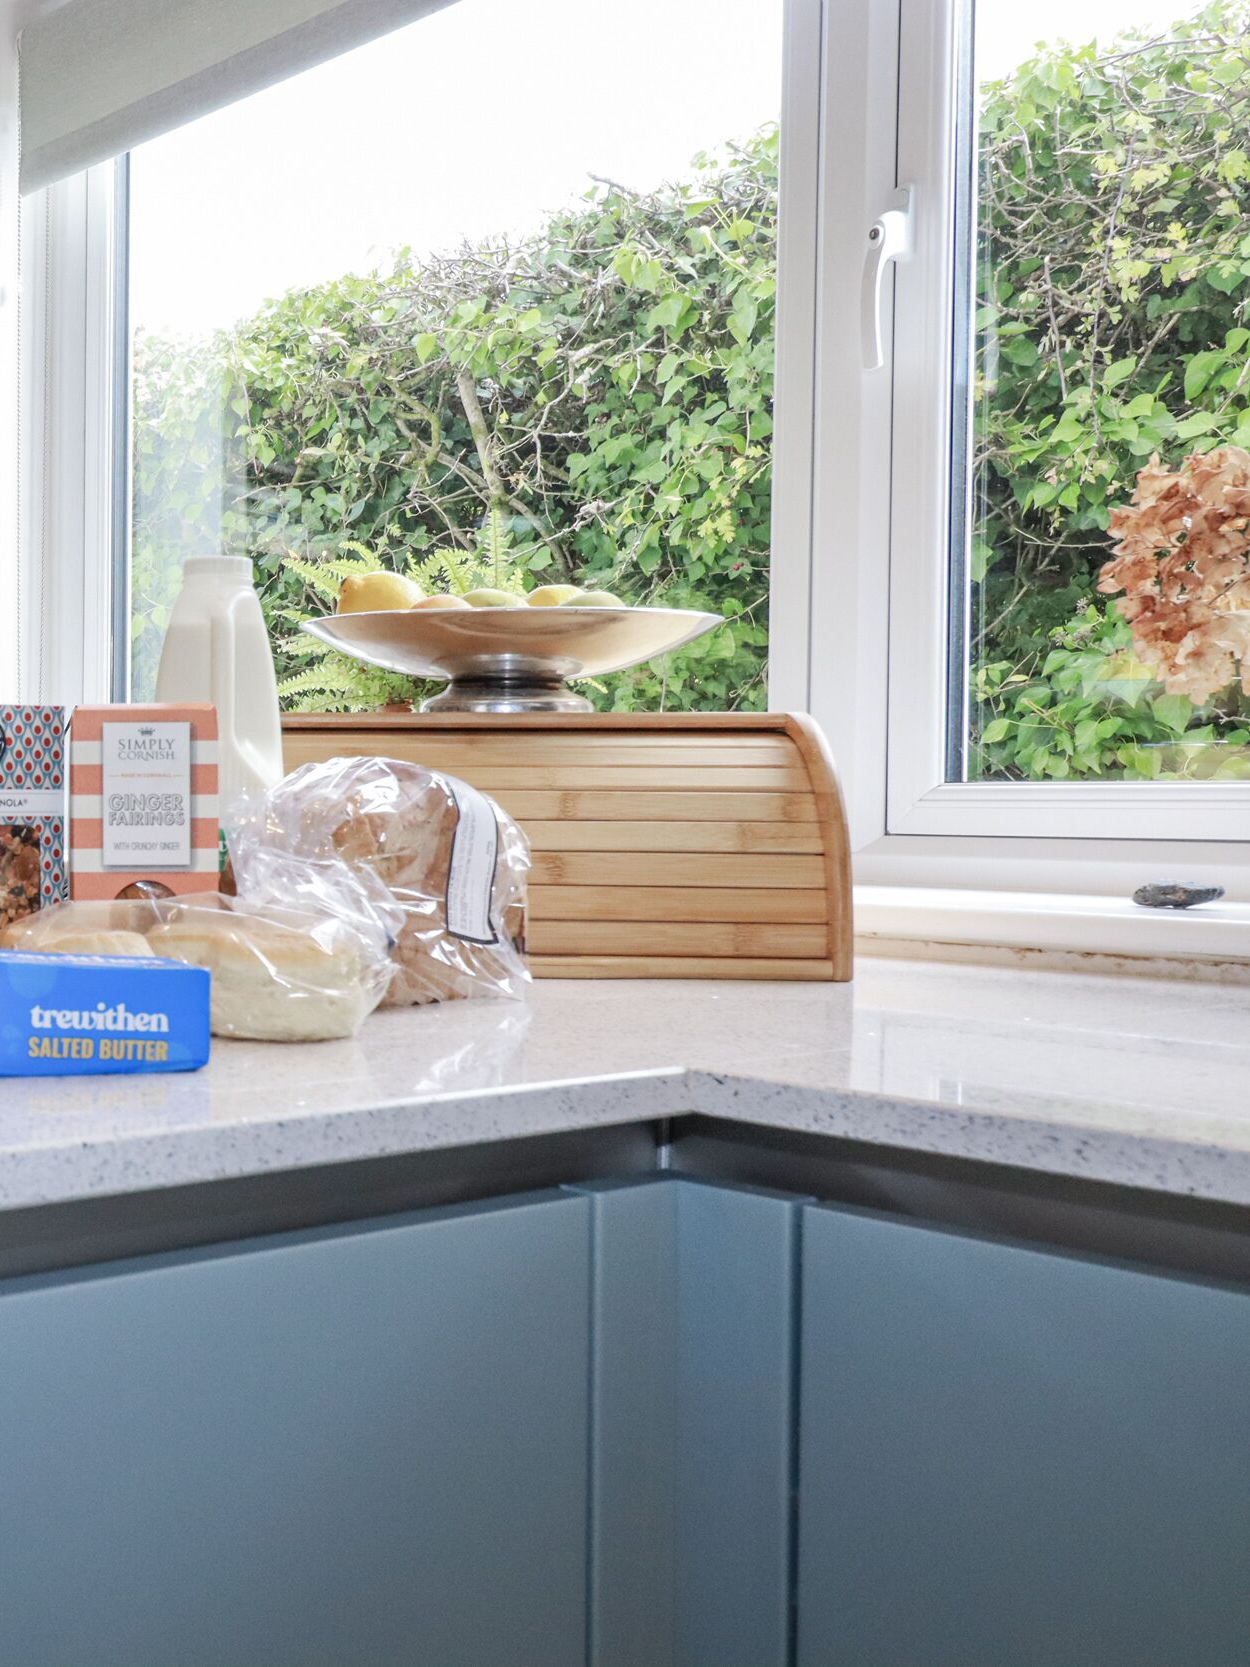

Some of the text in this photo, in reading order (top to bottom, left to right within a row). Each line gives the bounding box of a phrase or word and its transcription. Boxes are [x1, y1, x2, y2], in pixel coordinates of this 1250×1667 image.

[118, 738, 174, 751] SIMPLY
[118, 750, 174, 761] CORNISH
[108, 793, 184, 812] GINGER
[108, 811, 186, 826] FAIRINGS
[113, 841, 180, 851] WITH CRUNCHY GINGER
[30, 1002, 170, 1033] trewithen
[28, 1036, 168, 1062] SALTED BUTTER
